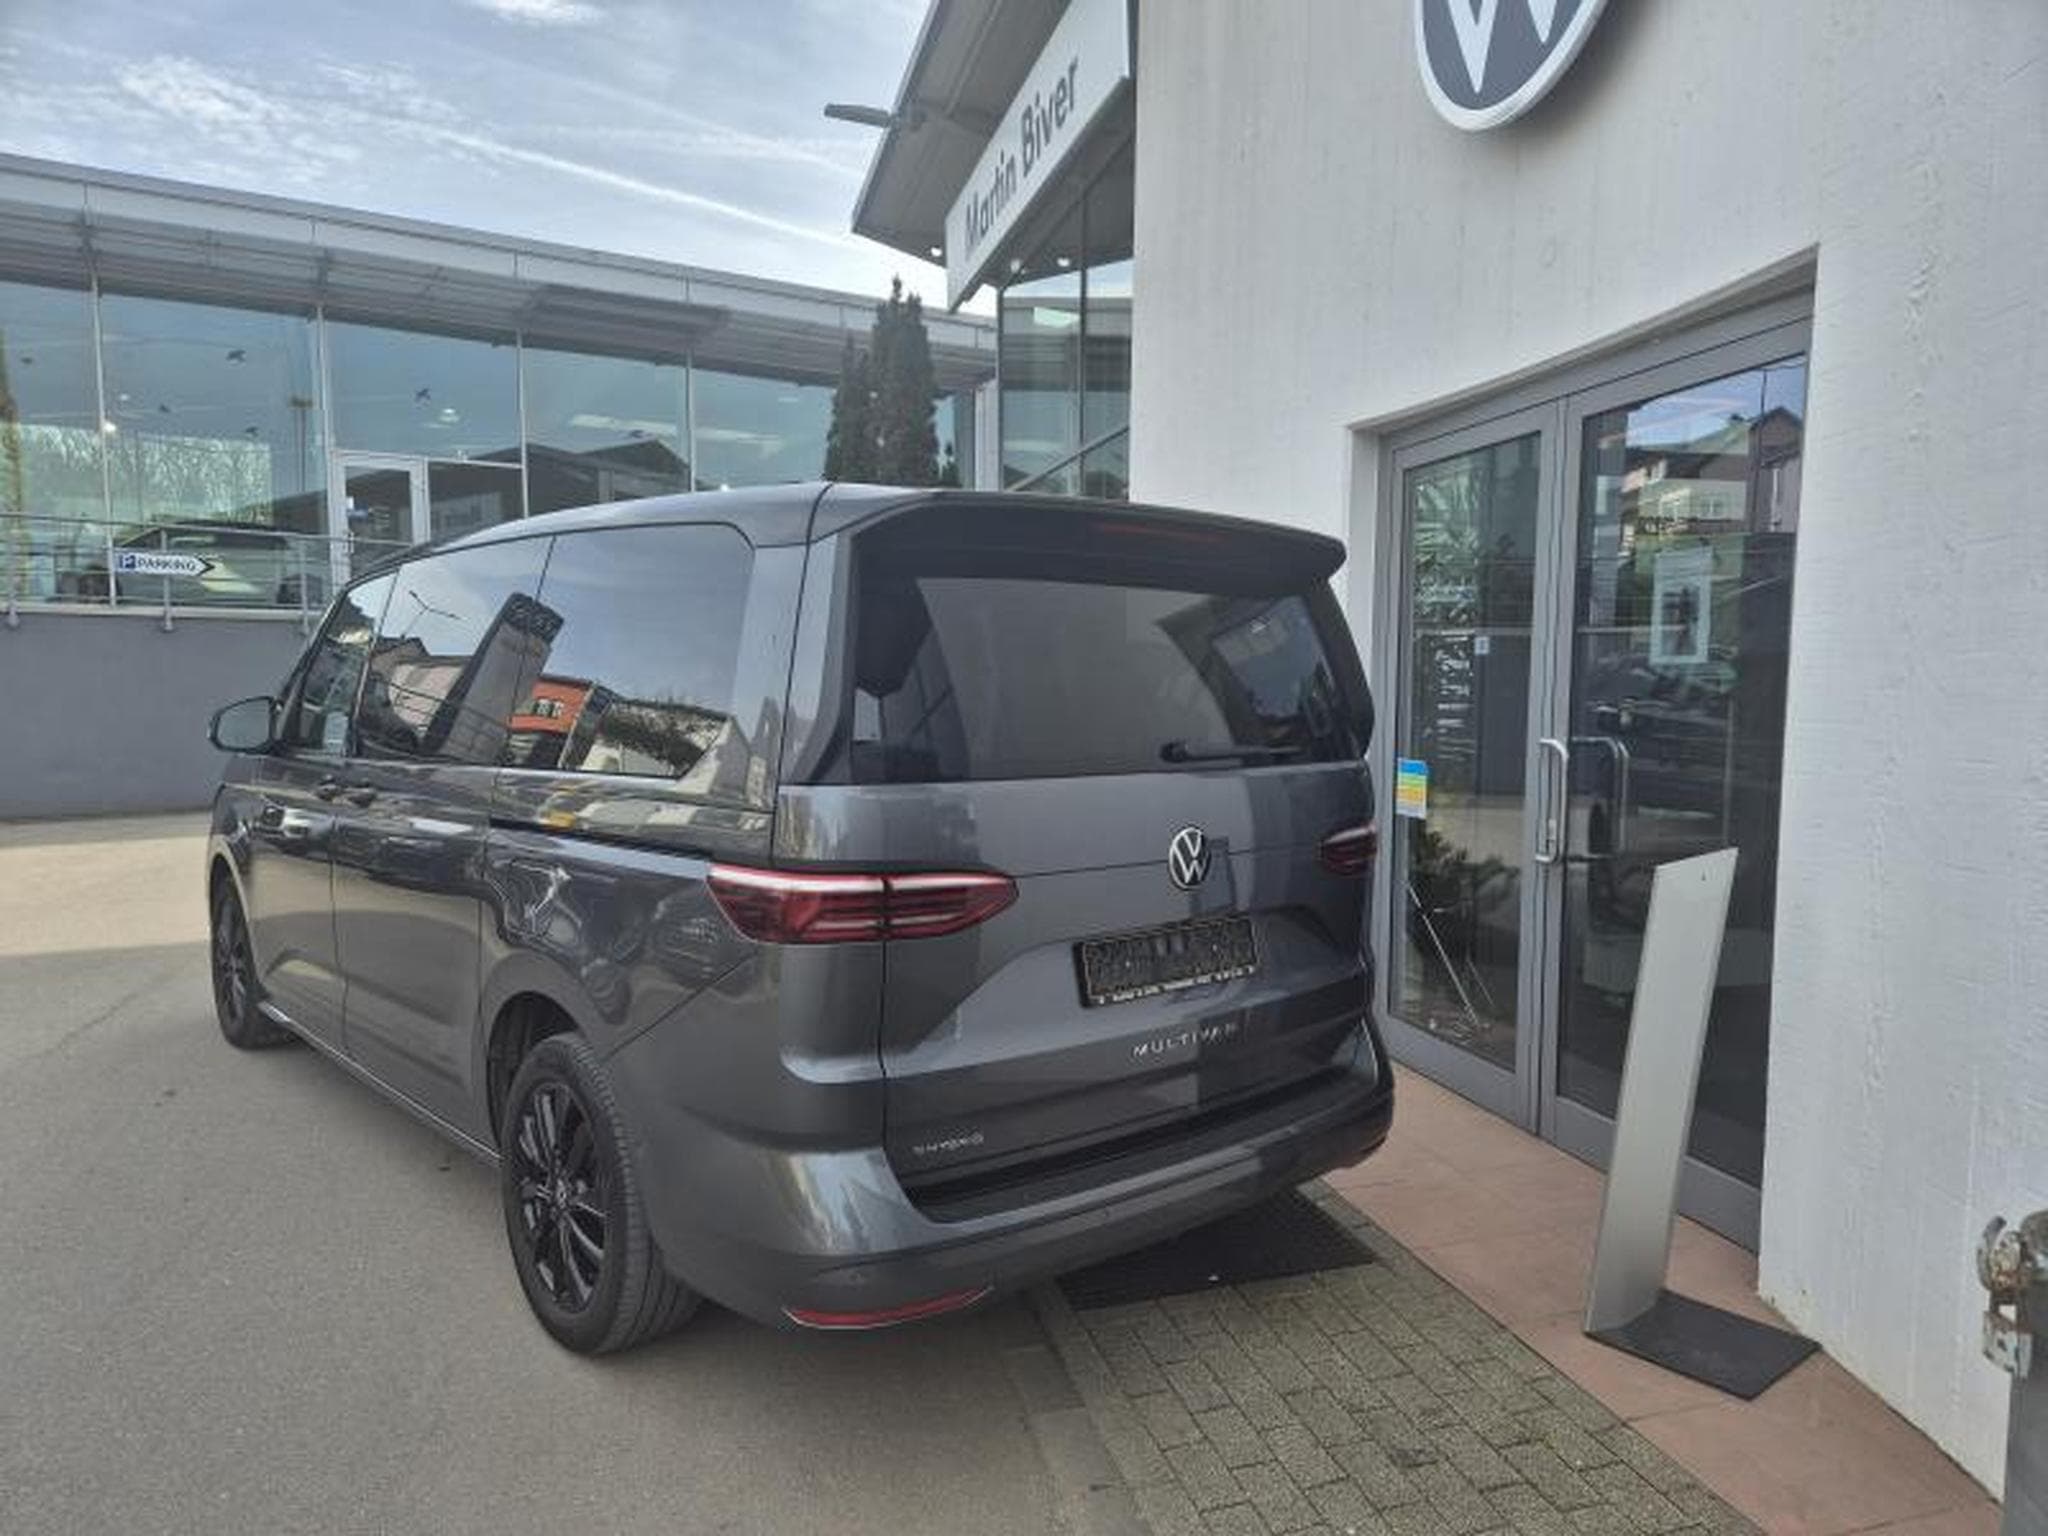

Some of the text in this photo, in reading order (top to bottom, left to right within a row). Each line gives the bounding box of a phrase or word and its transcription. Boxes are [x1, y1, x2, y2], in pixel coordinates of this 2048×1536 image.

[965, 56, 1079, 263] Martin Biver
[138, 557, 197, 572] PARKING
